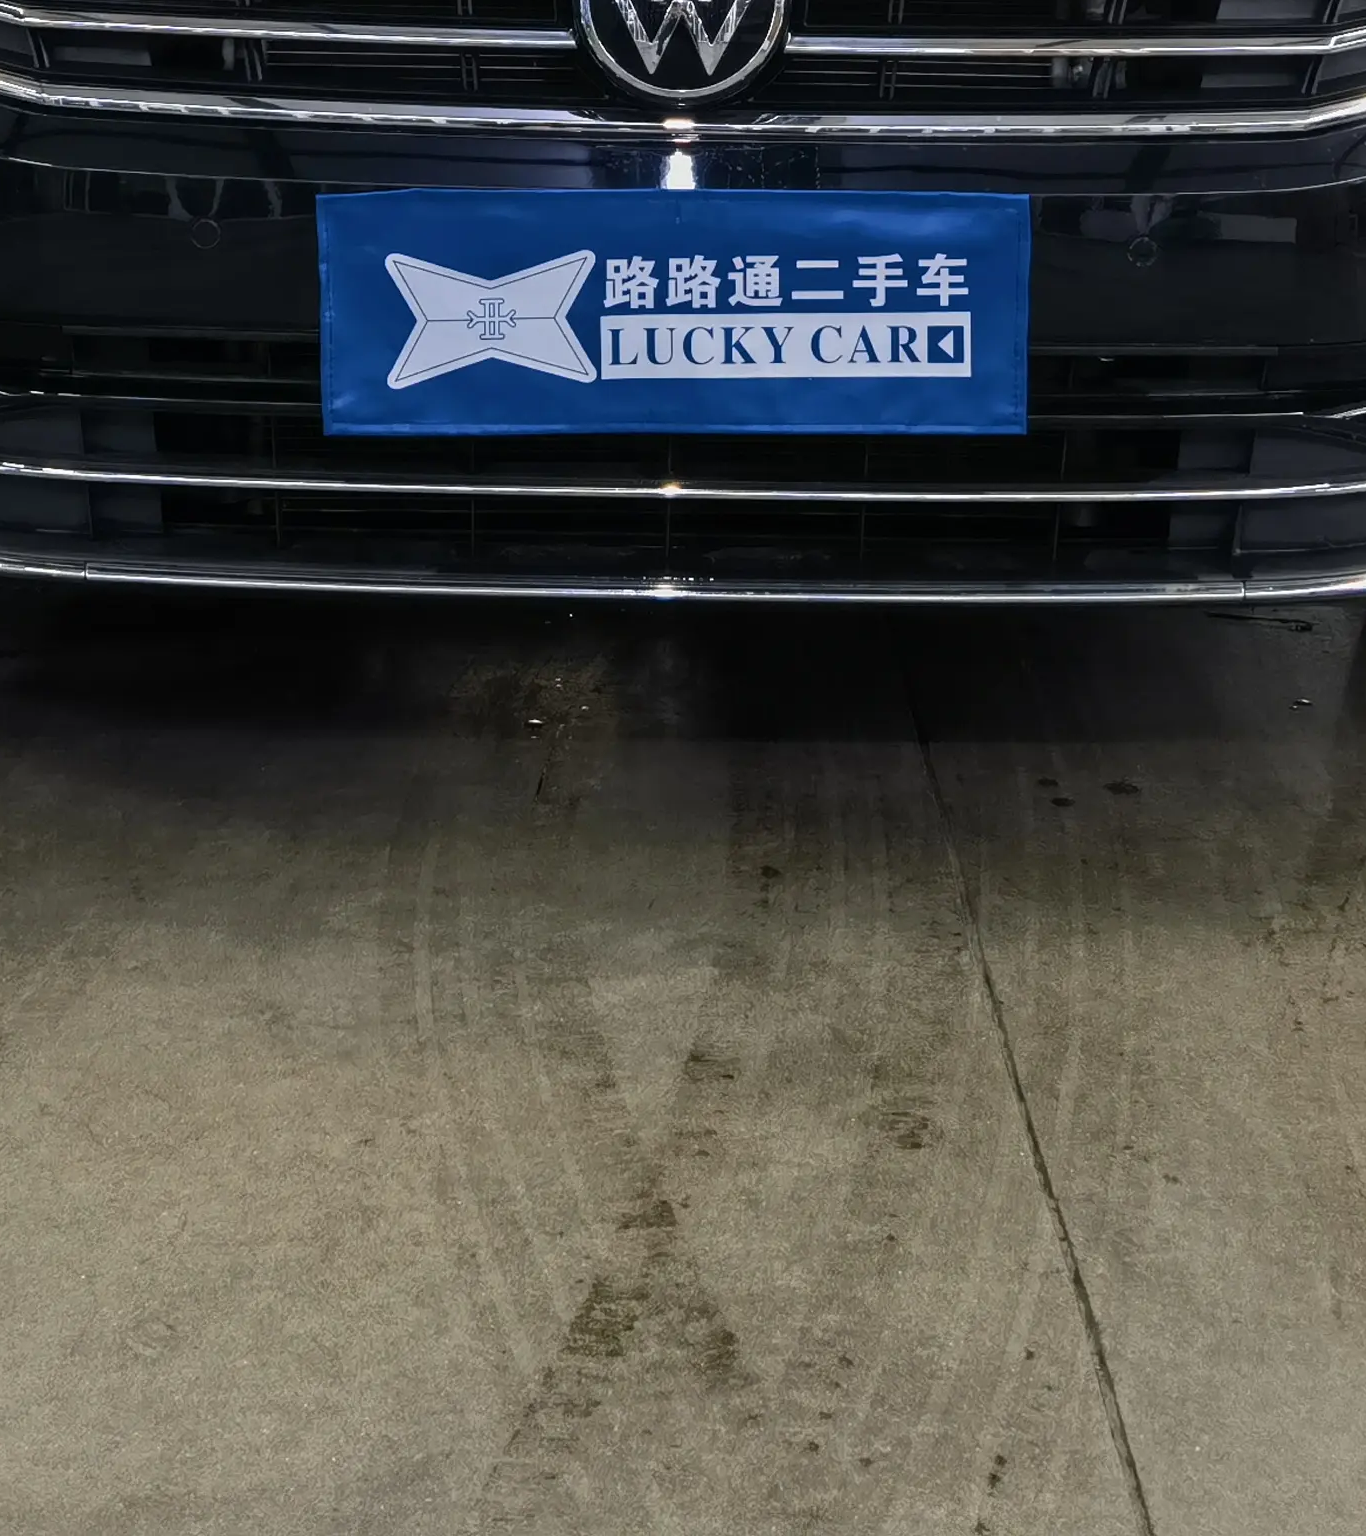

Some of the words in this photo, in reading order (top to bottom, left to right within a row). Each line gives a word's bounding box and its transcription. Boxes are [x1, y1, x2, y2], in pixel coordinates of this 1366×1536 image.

[604, 253, 971, 310] 路路通二手车
[607, 325, 794, 367] LUCKY
[810, 324, 926, 365] CAR
